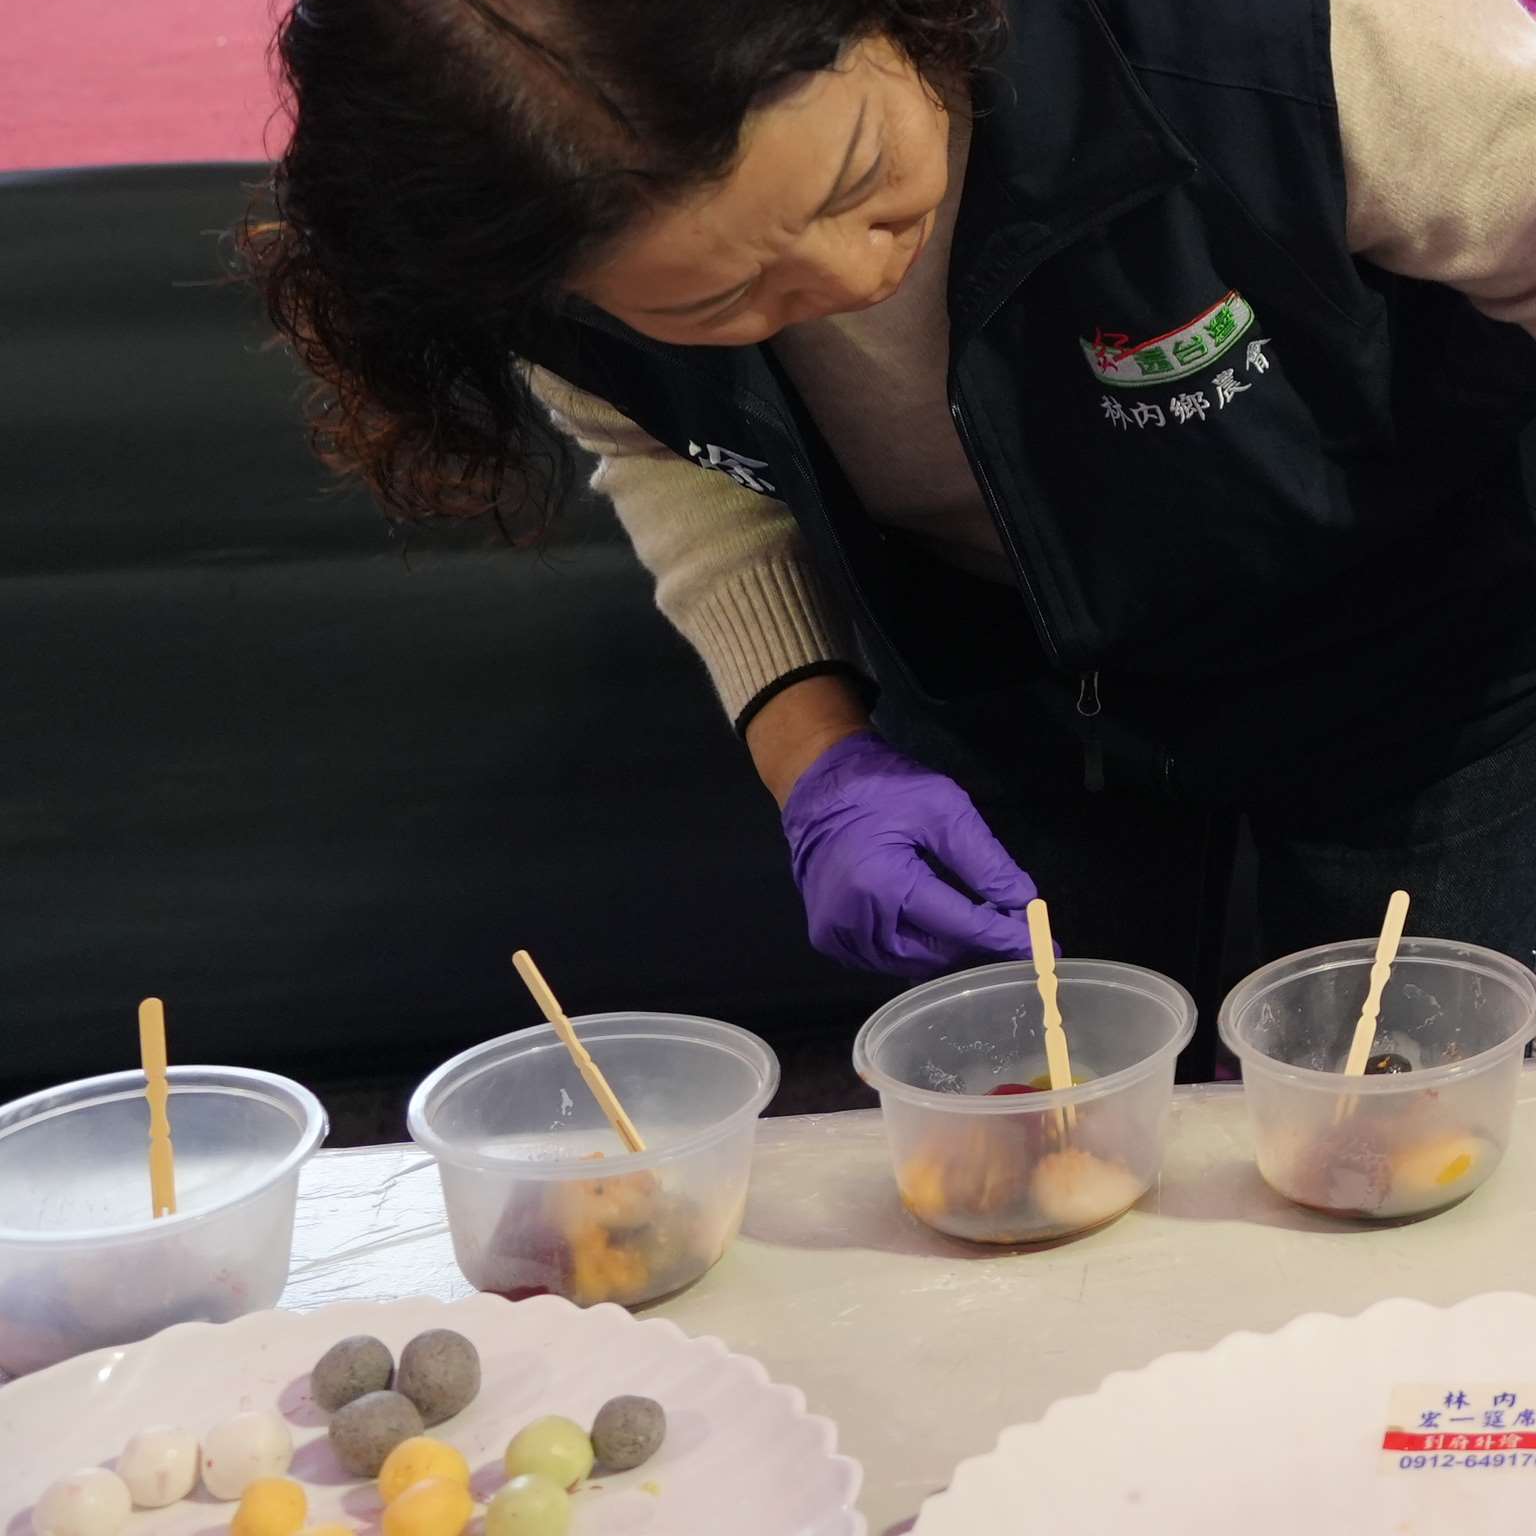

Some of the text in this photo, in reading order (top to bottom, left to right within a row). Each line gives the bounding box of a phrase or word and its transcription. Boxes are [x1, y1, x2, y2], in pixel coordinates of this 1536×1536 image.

[1100, 338, 1272, 432] 林內鄉農會
[1443, 1390, 1518, 1411] 林內
